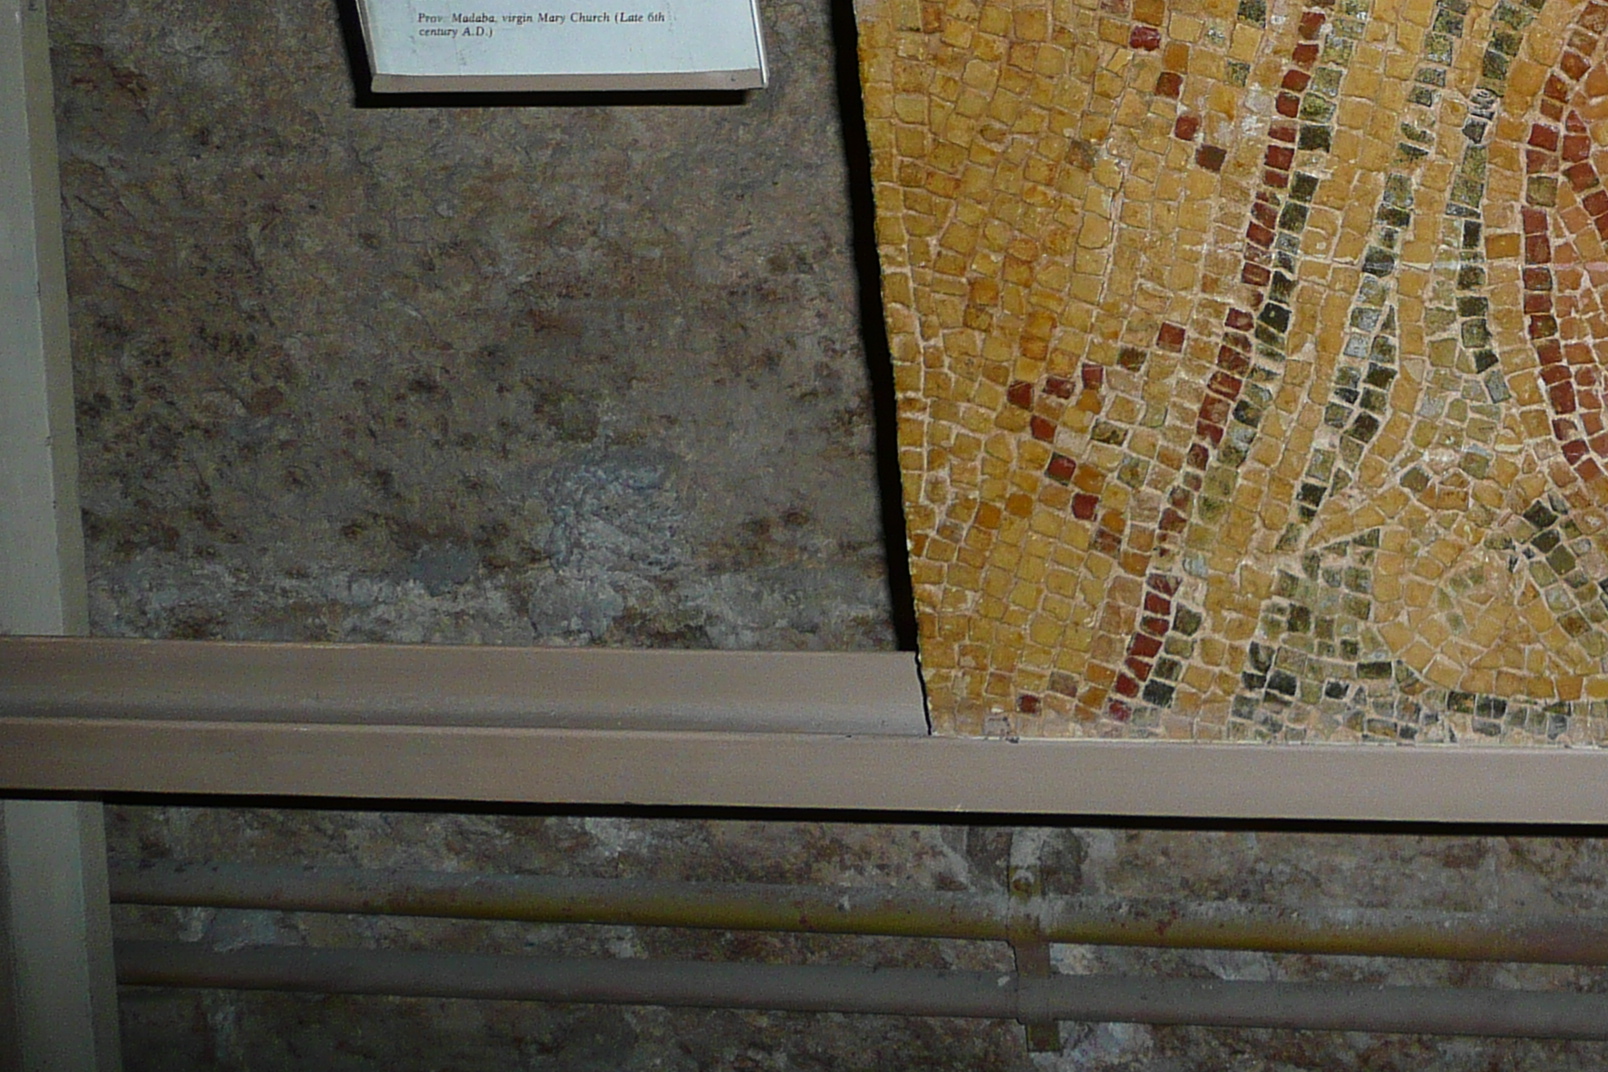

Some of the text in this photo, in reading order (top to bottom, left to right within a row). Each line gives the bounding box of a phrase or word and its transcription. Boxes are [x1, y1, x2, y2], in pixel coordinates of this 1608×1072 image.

[502, 12, 533, 26] virgin
[537, 12, 566, 24] Mary
[570, 12, 610, 24] Church
[614, 12, 644, 24] (Late
[647, 12, 665, 23] 6th
[418, 26, 493, 39] century A.D.)
